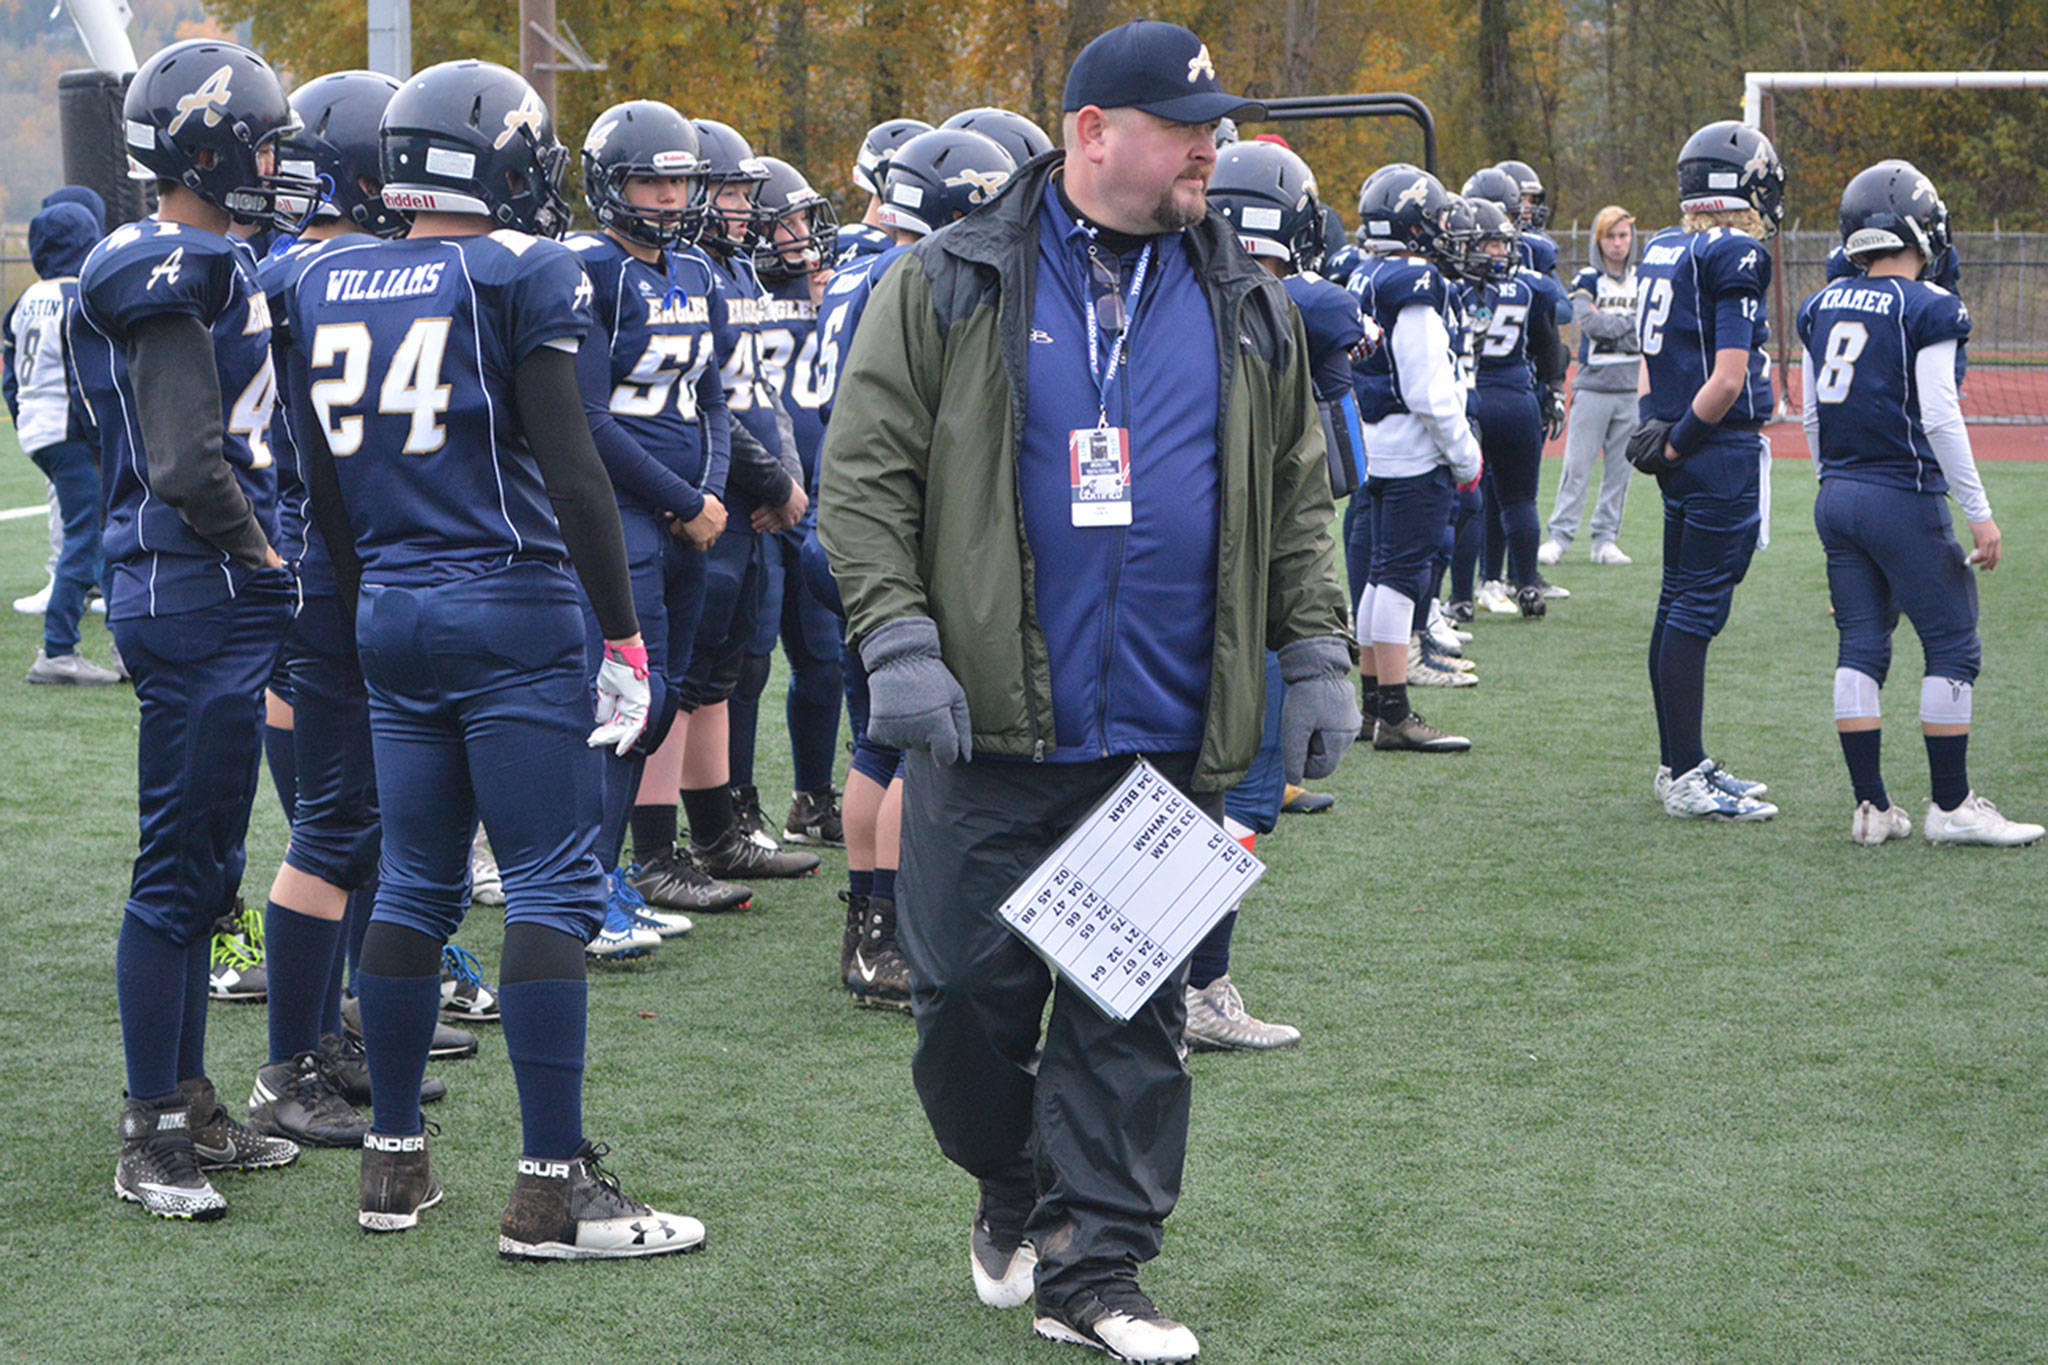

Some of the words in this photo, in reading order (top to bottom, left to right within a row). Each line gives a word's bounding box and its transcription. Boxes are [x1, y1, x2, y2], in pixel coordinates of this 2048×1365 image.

[146, 246, 184, 291] A
[325, 262, 446, 301] WILLIAMS
[1740, 296, 1759, 322] 12
[1818, 287, 1894, 315] KRAMER
[1636, 276, 1674, 357] 12
[1482, 304, 1529, 358] 5
[20, 327, 42, 387] 8
[1817, 321, 1869, 404] 8
[311, 317, 453, 457] 24
[1137, 772, 1153, 789] 34
[1152, 786, 1167, 802] 34
[1108, 789, 1139, 822] BEAR
[1166, 798, 1181, 814] 33
[1180, 811, 1195, 826] 33
[1134, 815, 1169, 853] WHAM
[1149, 825, 1180, 859] SLAM
[1208, 834, 1223, 849] 33
[1222, 846, 1238, 862] 32
[1236, 856, 1251, 874] 23
[1054, 870, 1069, 885] 02
[1038, 889, 1051, 902] 45
[1068, 881, 1083, 896] 04
[1053, 900, 1065, 916] 47
[1082, 893, 1097, 908] 23
[1022, 908, 1036, 923] 88
[1066, 912, 1080, 926] 66
[1096, 905, 1112, 920] 22
[1080, 924, 1094, 938] 65
[1111, 918, 1126, 931] 75
[1125, 928, 1139, 943] 21
[1107, 947, 1123, 962] 32
[1138, 940, 1154, 956] 24
[1123, 959, 1136, 975] 67
[1152, 952, 1168, 967] 25
[1091, 966, 1106, 981] 64
[1136, 971, 1150, 986] 68
[364, 1133, 425, 1152] UNDER
[519, 1160, 570, 1178] OUR
